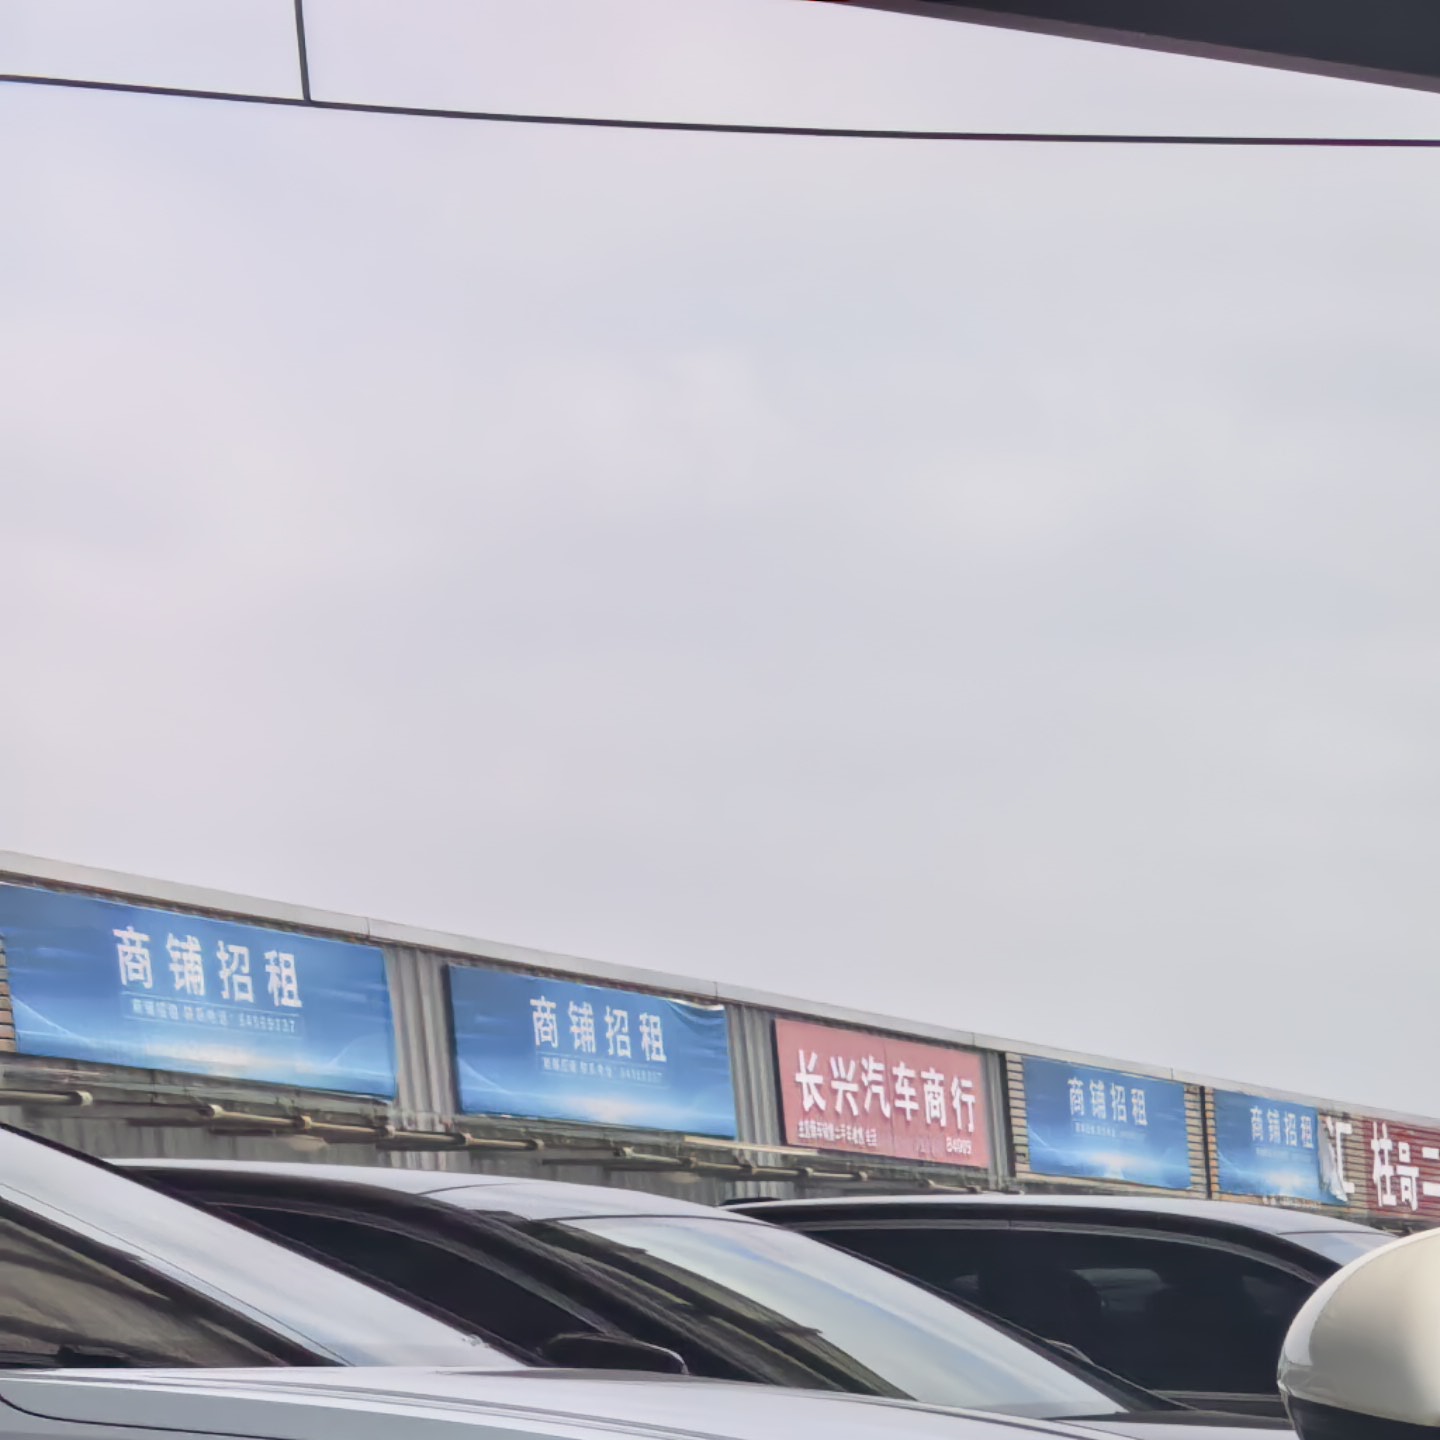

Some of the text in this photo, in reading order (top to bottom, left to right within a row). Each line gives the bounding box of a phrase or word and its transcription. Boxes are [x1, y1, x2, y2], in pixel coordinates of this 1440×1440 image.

[112, 926, 302, 1008] 商铺招租
[530, 995, 667, 1062] 商铺招租
[795, 1049, 976, 1133] 长兴汽车商行
[1067, 1076, 1148, 1126] 商铺招租
